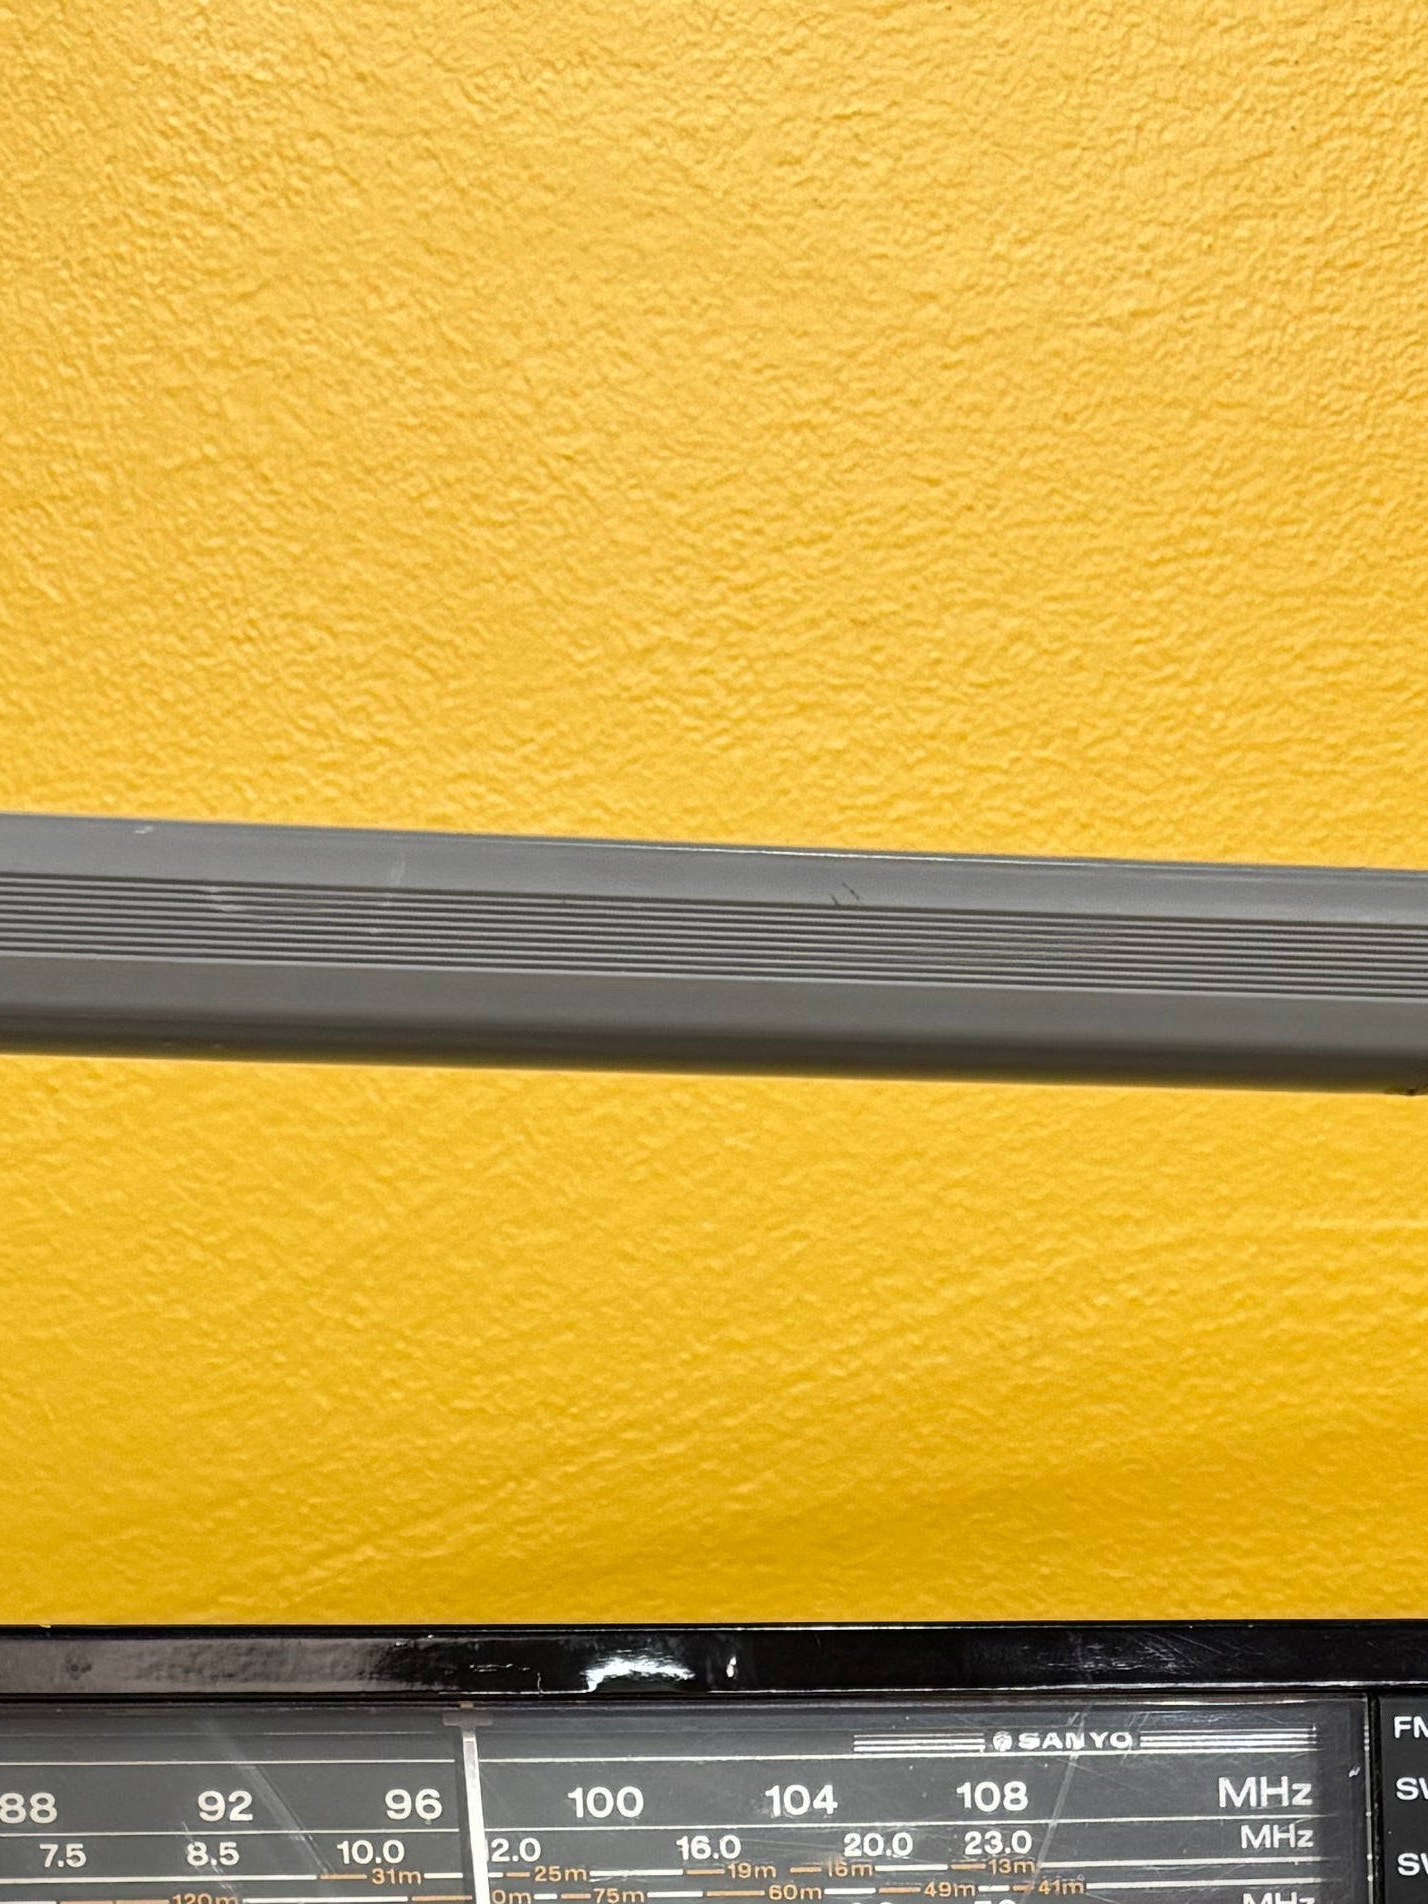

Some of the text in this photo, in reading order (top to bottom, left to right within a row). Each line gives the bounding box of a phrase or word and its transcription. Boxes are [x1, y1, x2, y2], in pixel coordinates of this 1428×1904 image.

[1017, 1731, 1134, 1751] SANYO
[197, 1789, 254, 1824] 92
[384, 1788, 443, 1822] 96
[567, 1785, 645, 1820] 100
[764, 1783, 839, 1818] 104
[956, 1780, 1029, 1813] 108
[1217, 1775, 1314, 1809] MHz
[38, 1842, 88, 1870] 7.5
[185, 1841, 240, 1867] 8.5
[336, 1838, 405, 1866] 10.0
[485, 1837, 542, 1864] 2.0
[675, 1834, 743, 1861] 16.0
[843, 1831, 914, 1858] 20.0
[963, 1829, 1033, 1856] 23.0
[1240, 1824, 1315, 1850] MHz
[371, 1867, 421, 1886] 31m
[533, 1865, 587, 1883] 25m
[726, 1862, 777, 1880] 19m
[988, 1857, 1036, 1875] 13m
[592, 1887, 646, 1904] 75m
[768, 1884, 823, 1902] 60m
[923, 1880, 977, 1898] 49m
